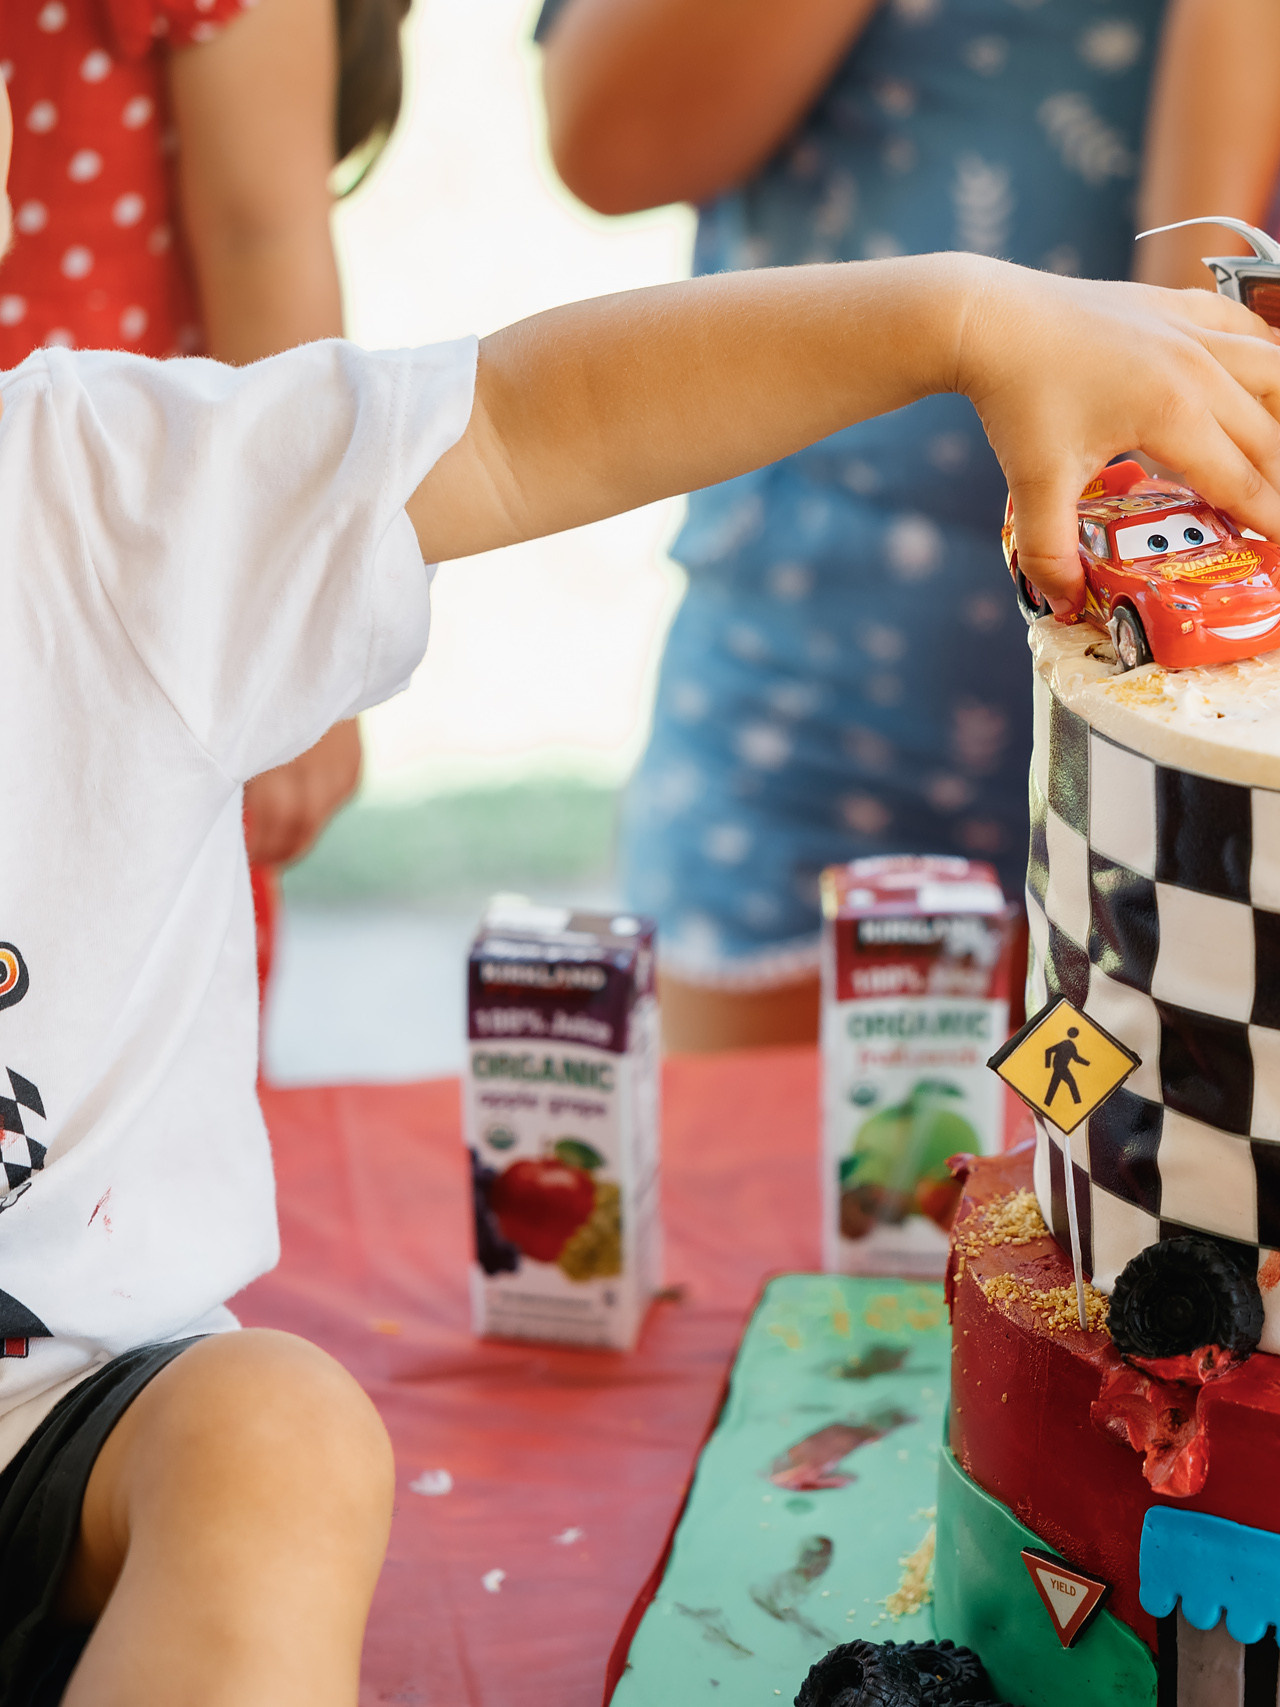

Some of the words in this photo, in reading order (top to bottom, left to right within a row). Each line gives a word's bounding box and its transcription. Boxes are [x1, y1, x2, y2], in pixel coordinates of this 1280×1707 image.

[848, 1011, 990, 1041] ORGANIC
[473, 1052, 615, 1093] ORGANIC
[1050, 1577, 1077, 1597] YIELD
